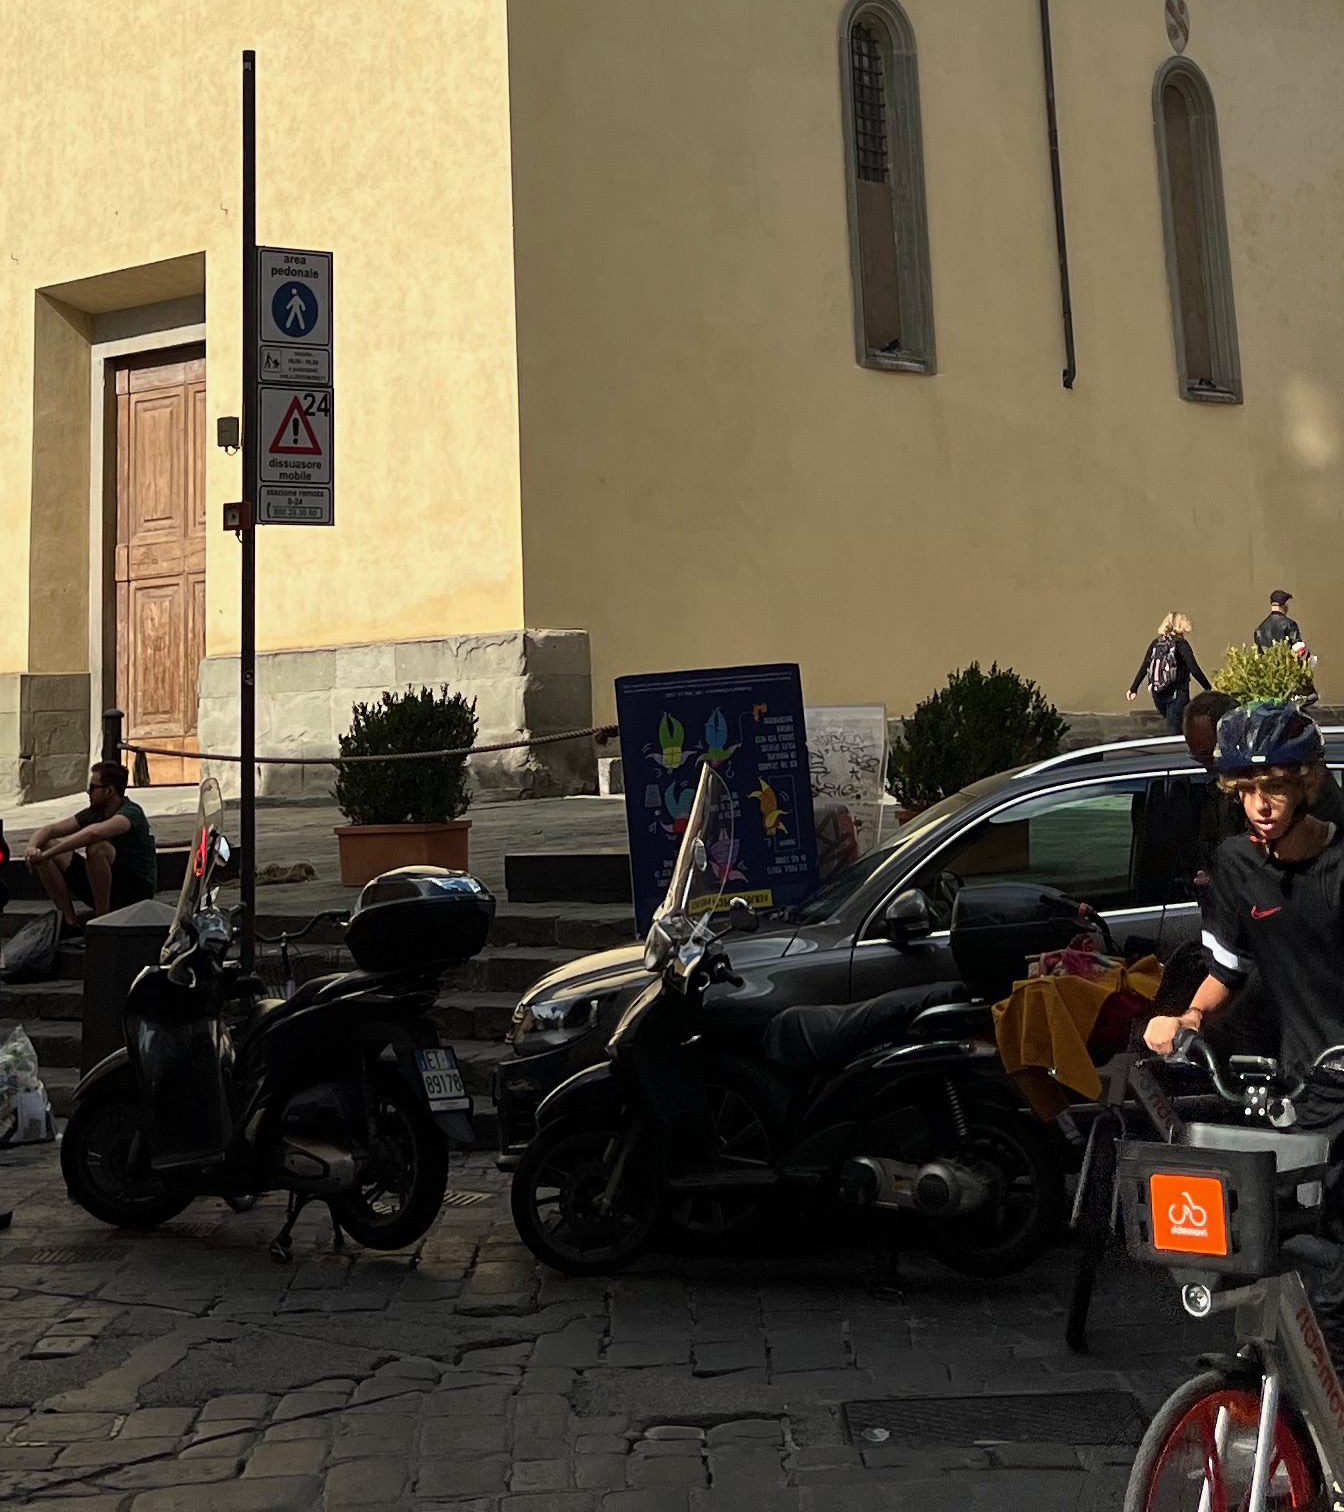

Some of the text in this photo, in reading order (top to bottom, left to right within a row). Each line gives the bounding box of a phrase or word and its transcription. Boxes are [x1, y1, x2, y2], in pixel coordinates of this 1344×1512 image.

[284, 255, 307, 265] area
[271, 266, 319, 279] pedonale
[303, 392, 330, 417] 24
[268, 457, 322, 470] dissuasore
[279, 471, 312, 481] mobile
[425, 1050, 442, 1070] ET
[425, 1074, 462, 1094] 89178
